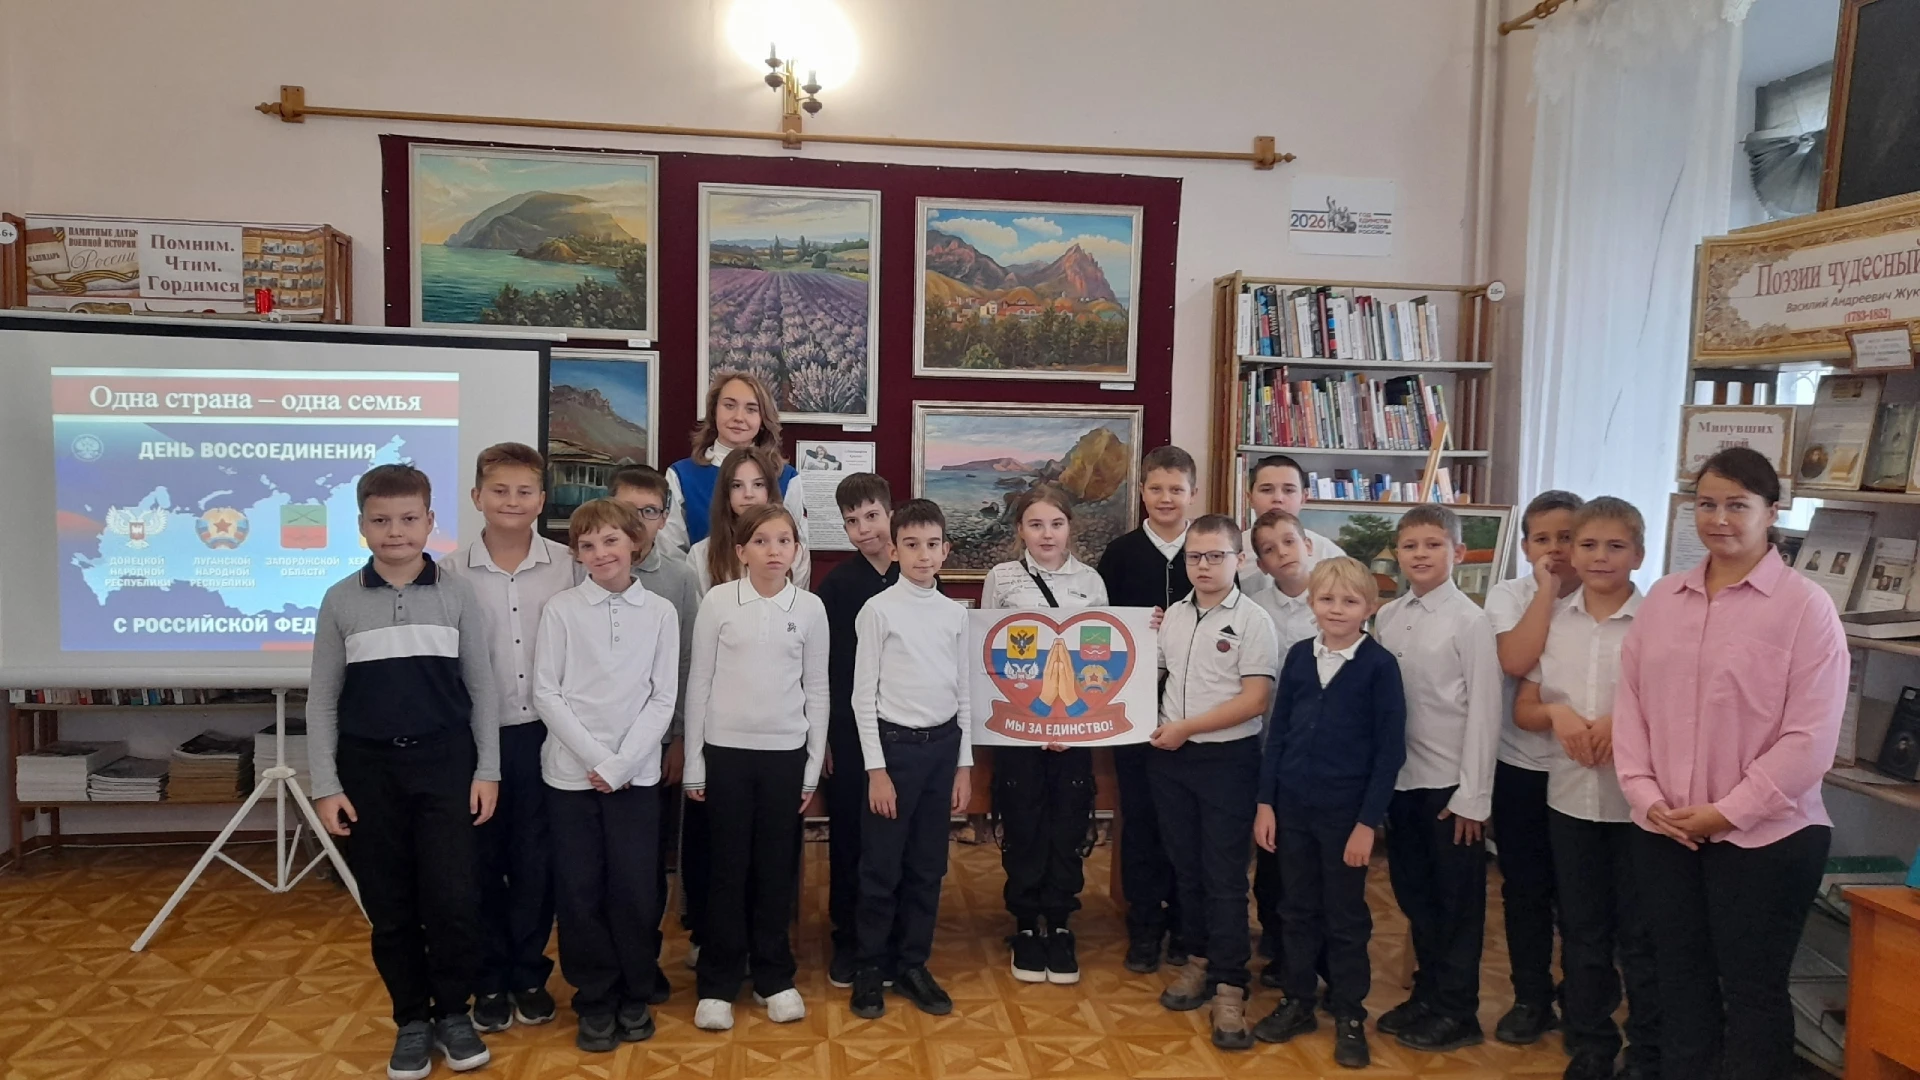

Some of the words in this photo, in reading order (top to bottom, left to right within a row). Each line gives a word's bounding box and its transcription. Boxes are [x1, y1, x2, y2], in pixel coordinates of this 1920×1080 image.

[1290, 213, 1326, 229] 2026
[0, 229, 14, 237] 6+
[68, 227, 113, 237] ПАМЯТНЫЕ
[115, 229, 138, 238] ДАТЫ
[68, 237, 102, 247] ВОЕННОЙ
[104, 239, 137, 249] ИСТОРИИ
[150, 233, 235, 253] Помним.
[71, 249, 136, 269] России
[164, 254, 223, 273] Чтим.
[147, 276, 240, 295] Гордимся
[1755, 263, 1822, 297] Поэзии
[1785, 299, 1828, 314] Василий
[1831, 290, 1892, 308] Андреевич
[1893, 288, 1920, 302] Жук
[89, 384, 159, 410] Одна
[165, 389, 252, 415] страна
[281, 391, 341, 413] одна
[347, 393, 422, 412] семья
[1697, 421, 1774, 435] Минувших
[138, 441, 194, 461] ДЕНЬ
[200, 441, 376, 461] ВОССОЕДИНЕНИЯ
[109, 555, 165, 566] ДОНЕЦКОЙ
[192, 555, 251, 566] ЛУГАНСКОЙ
[265, 556, 340, 566] ЗАПОРОЖСКОЙ
[110, 566, 165, 576] НАРОДНОЙ
[195, 566, 250, 577] НАРОДНОЙ
[281, 566, 326, 577] ОБЛАСТИ
[104, 577, 172, 588] РЕСПУБЛИКИ
[189, 577, 256, 588] РЕСПУБЛИКИ
[114, 618, 127, 634] С
[133, 613, 269, 634] РОССИЙСКОЙ
[274, 617, 316, 635] ФЕД
[1004, 718, 1025, 732] МЫ
[1028, 721, 1043, 735] ЗА
[1046, 719, 1114, 737] ЕДИНСТВО!
